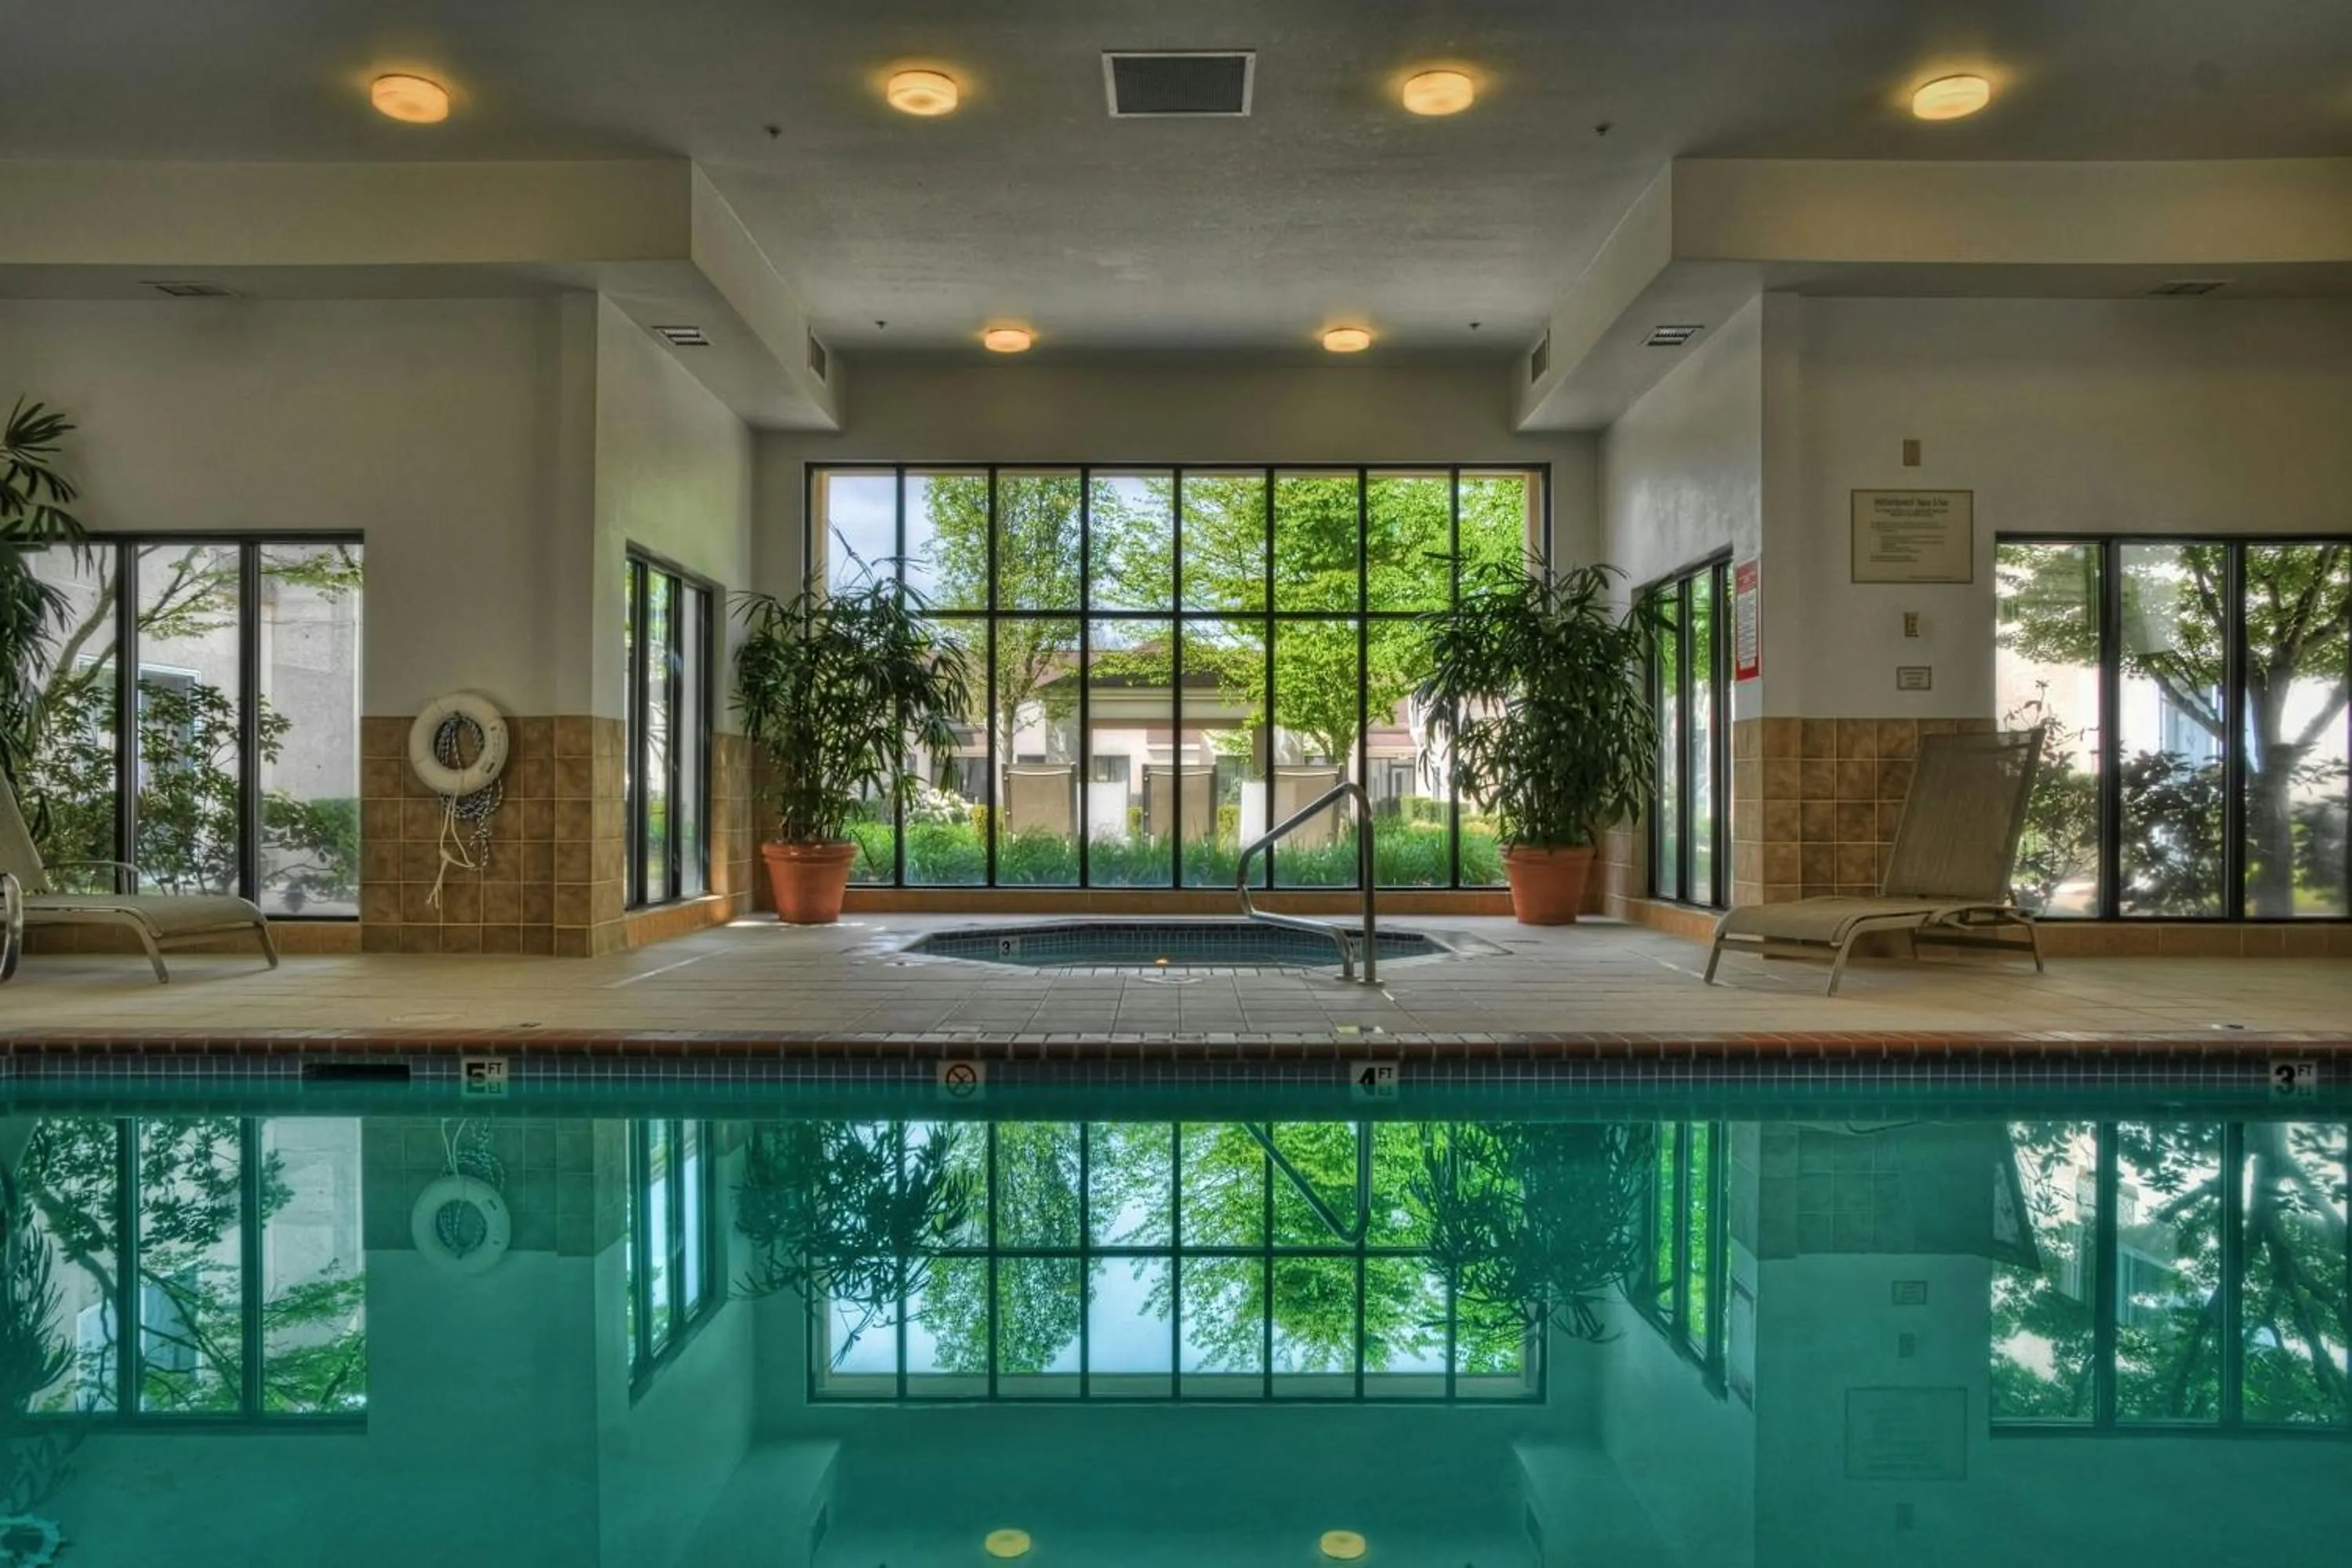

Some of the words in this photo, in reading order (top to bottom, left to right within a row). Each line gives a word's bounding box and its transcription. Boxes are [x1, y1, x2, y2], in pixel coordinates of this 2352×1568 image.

[466, 1062, 485, 1083] 5
[488, 1062, 503, 1075] FT
[1359, 1067, 1376, 1085] 4
[1378, 1067, 1393, 1079] FT
[2275, 1064, 2296, 1084] 3
[2298, 1065, 2313, 1077] FT
